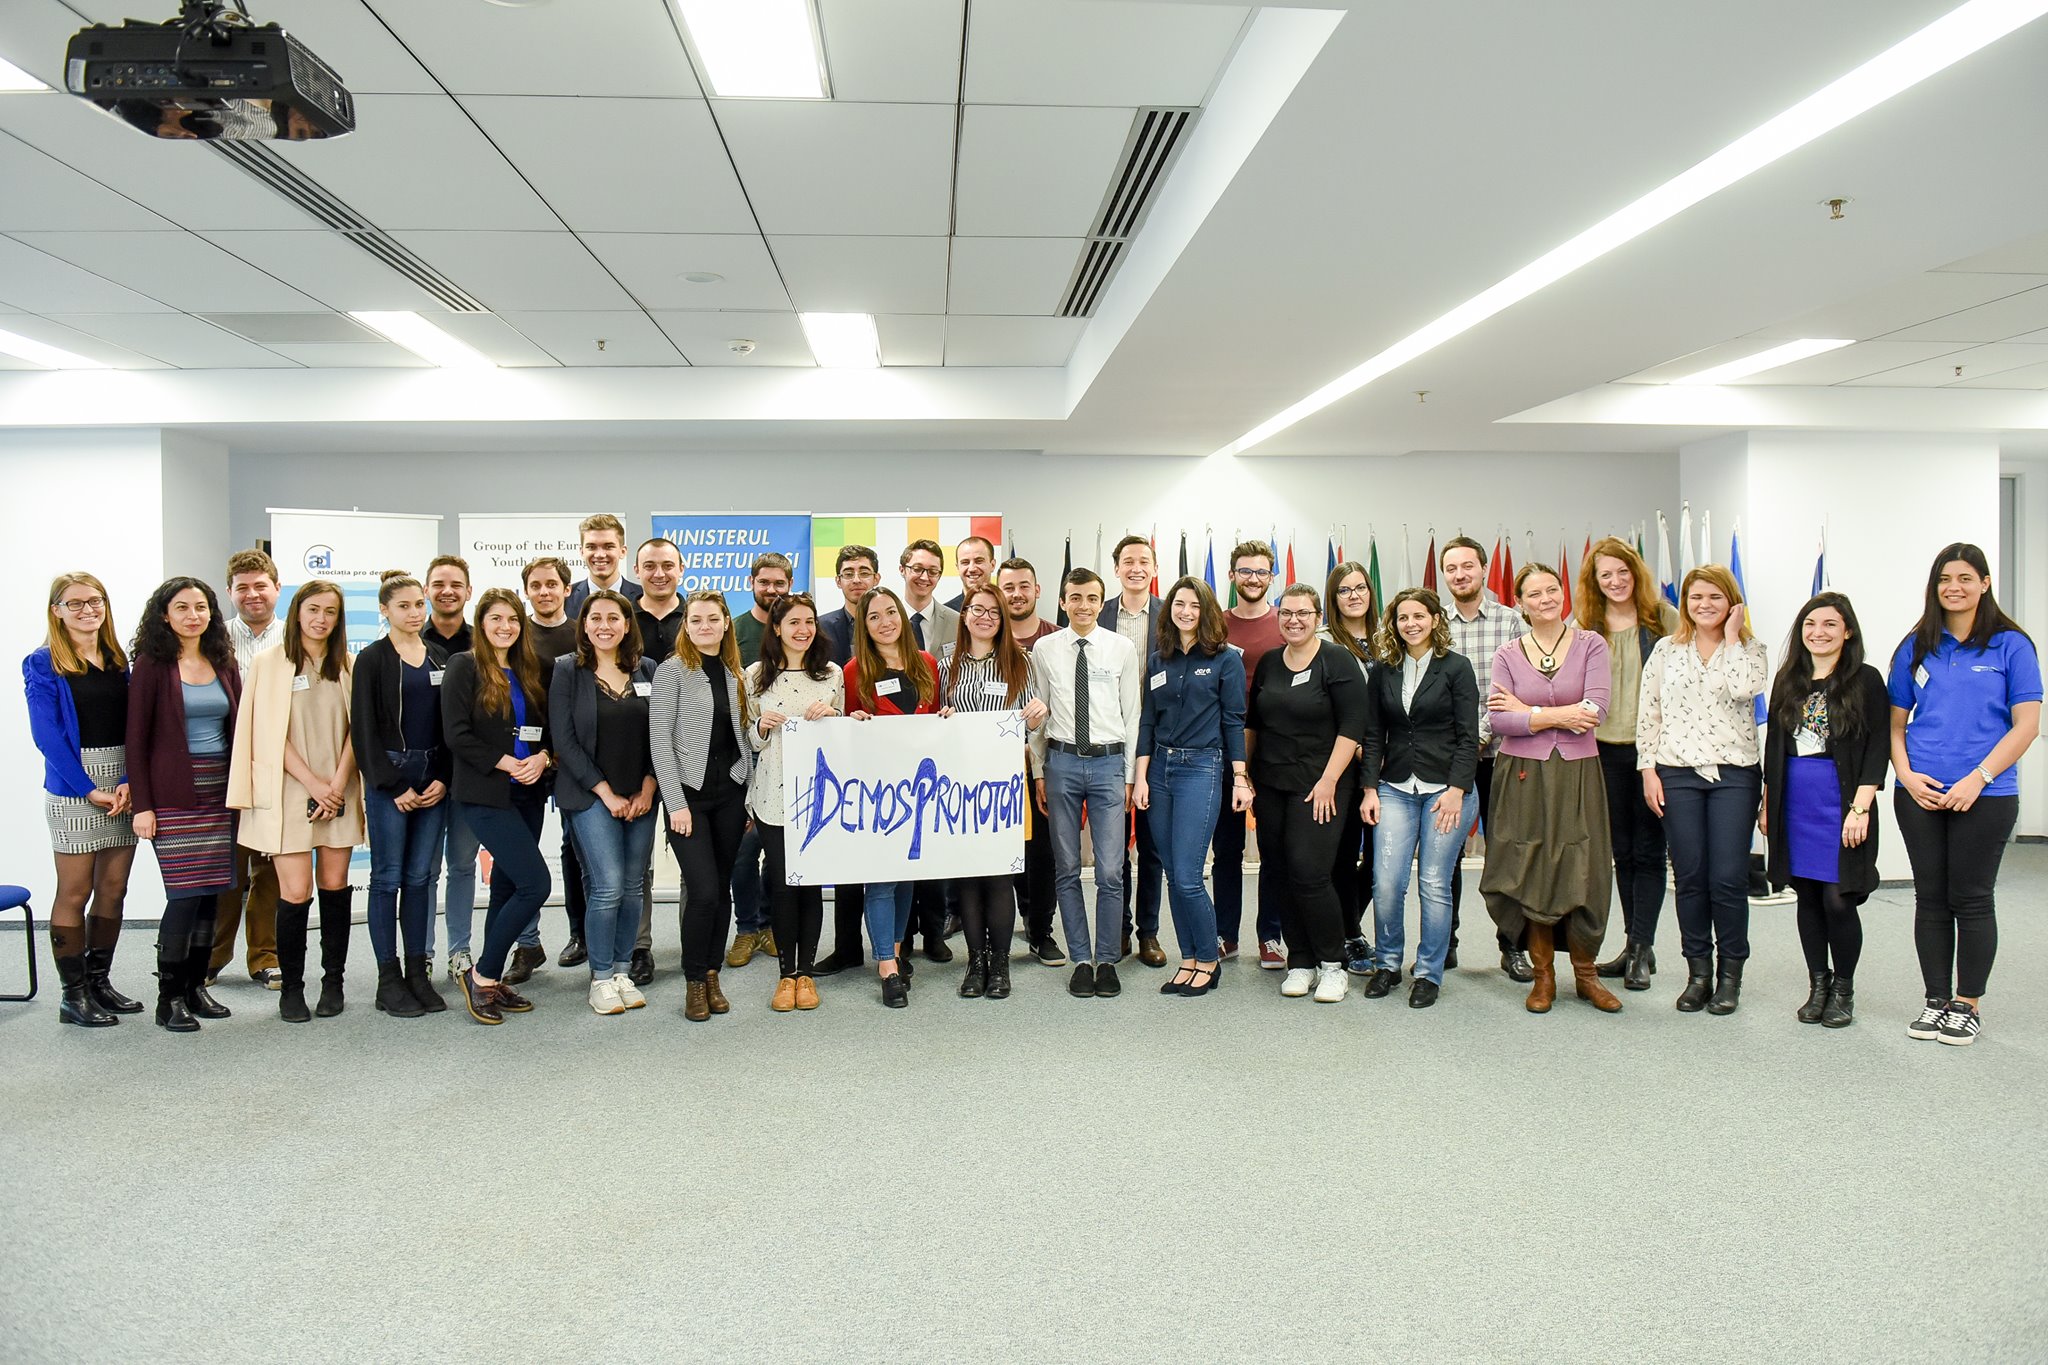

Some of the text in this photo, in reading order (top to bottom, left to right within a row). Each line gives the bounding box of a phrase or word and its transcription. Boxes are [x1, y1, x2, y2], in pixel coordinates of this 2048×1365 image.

[663, 529, 770, 546] MINISTERUL
[473, 541, 512, 554] Group
[516, 540, 530, 551] of
[534, 540, 554, 551] the
[491, 556, 527, 567] Youth
